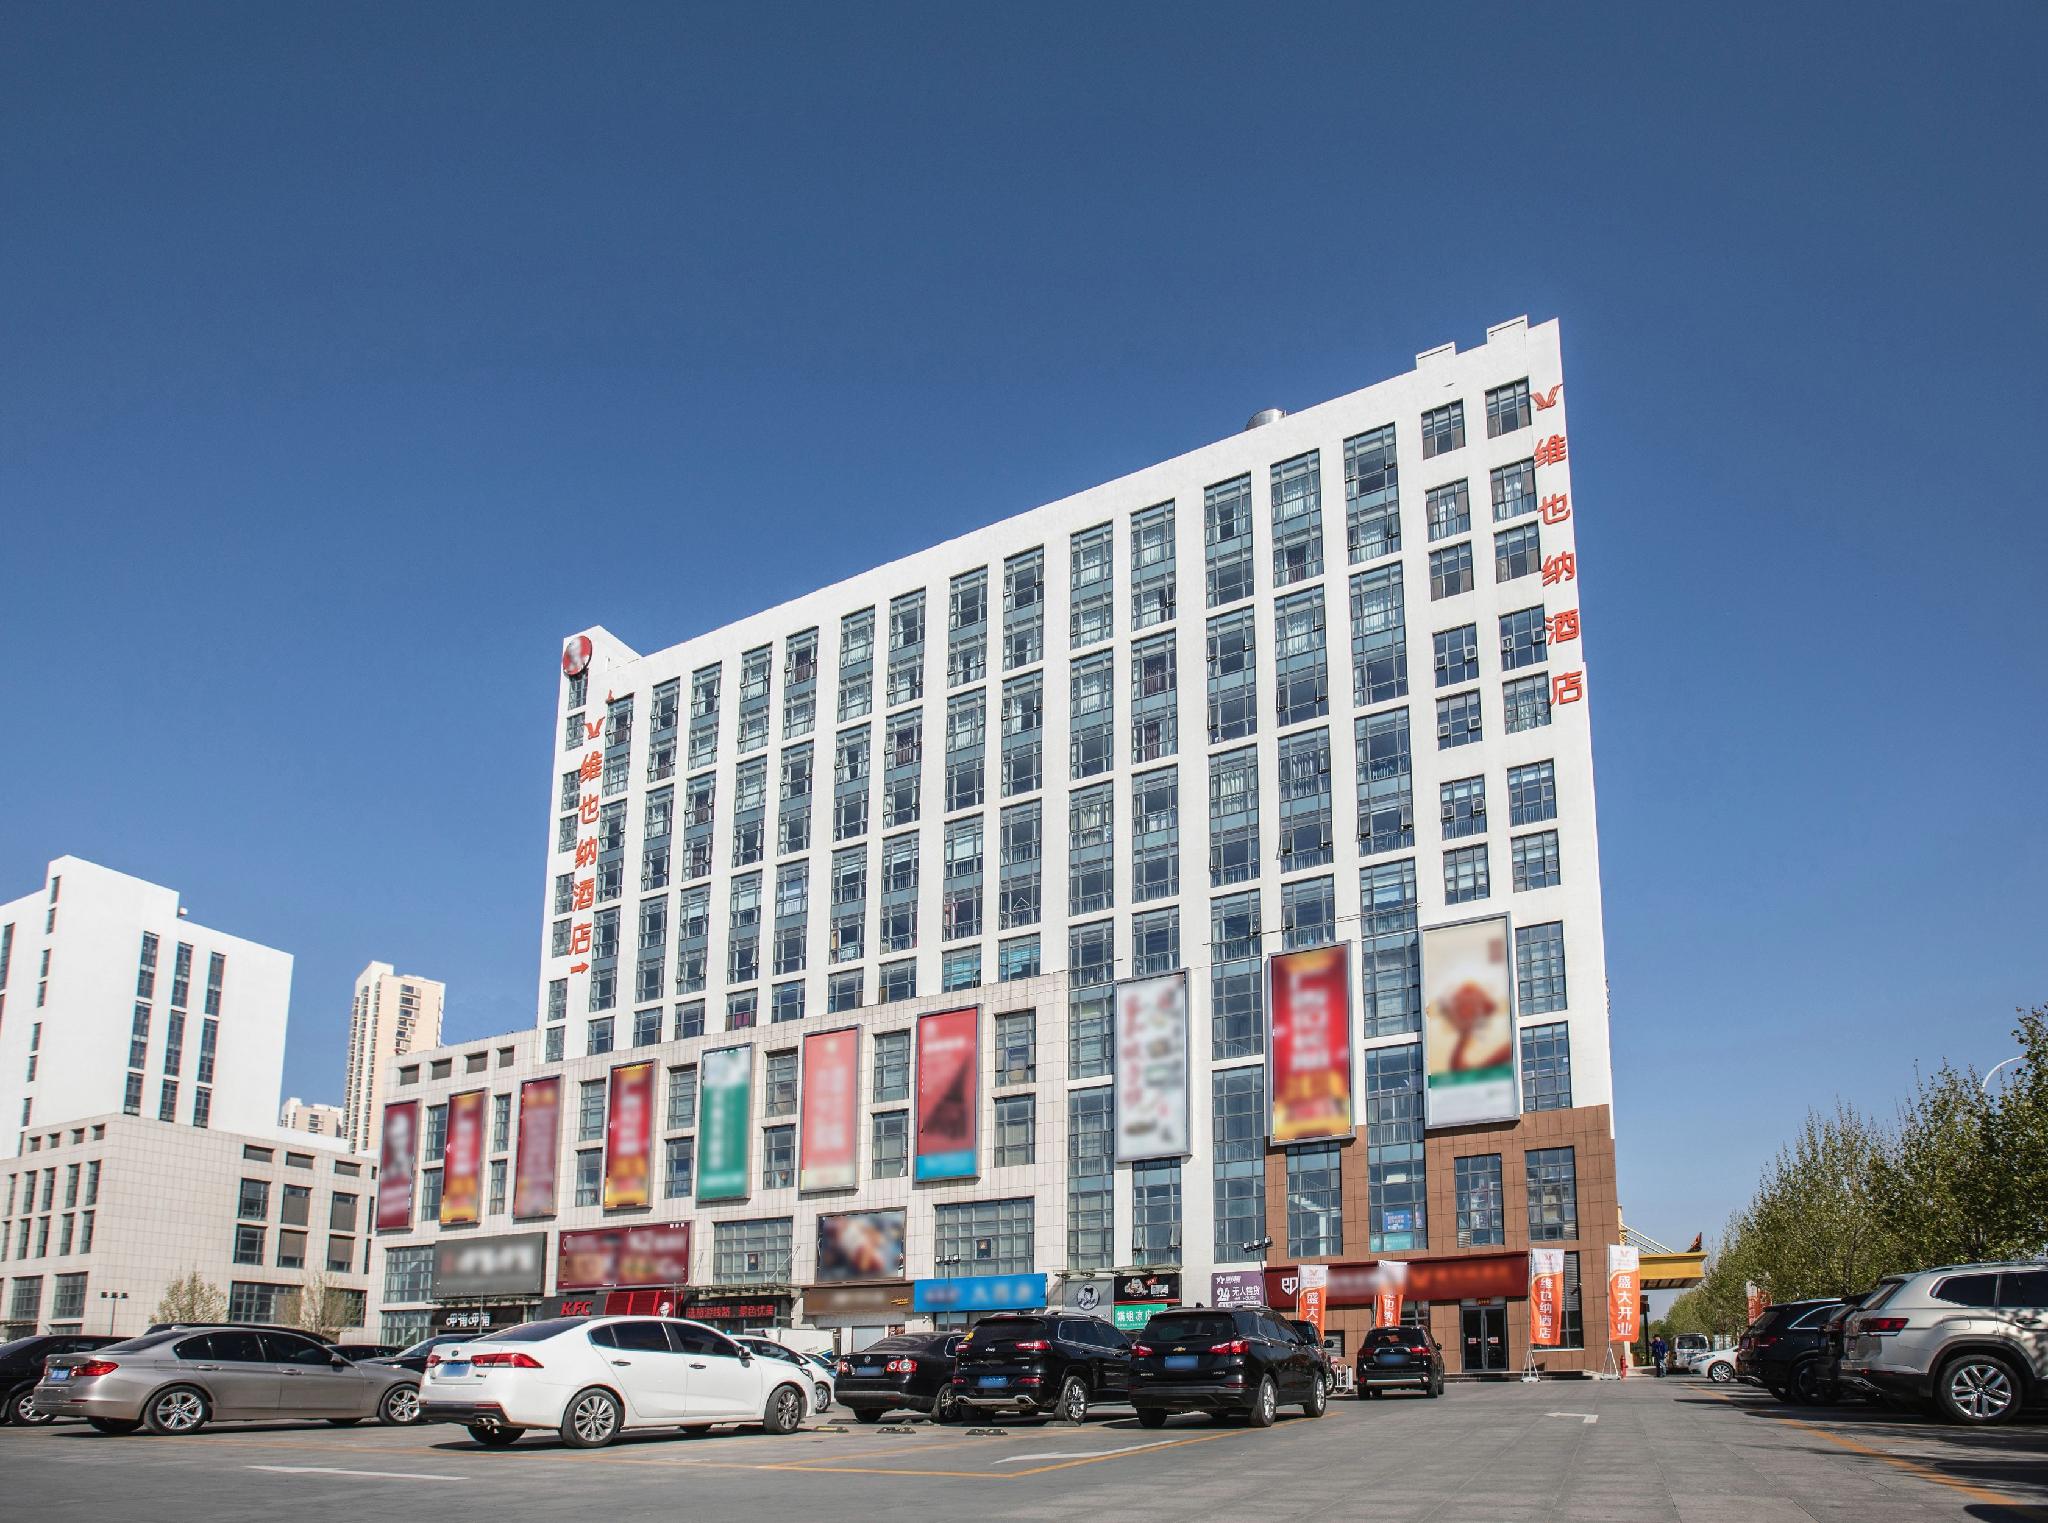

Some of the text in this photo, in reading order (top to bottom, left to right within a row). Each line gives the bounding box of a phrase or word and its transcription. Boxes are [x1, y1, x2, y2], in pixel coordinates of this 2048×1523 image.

[1534, 434, 1582, 705] 维也纳酒店
[569, 751, 602, 956] 维也纳酒店
[560, 1301, 593, 1316] KFC
[1216, 1287, 1230, 1301] 24
[1232, 1285, 1260, 1297] 无人售货
[1539, 1277, 1553, 1339] 维也纳酒店
[1617, 1275, 1632, 1336] 盛大开业
